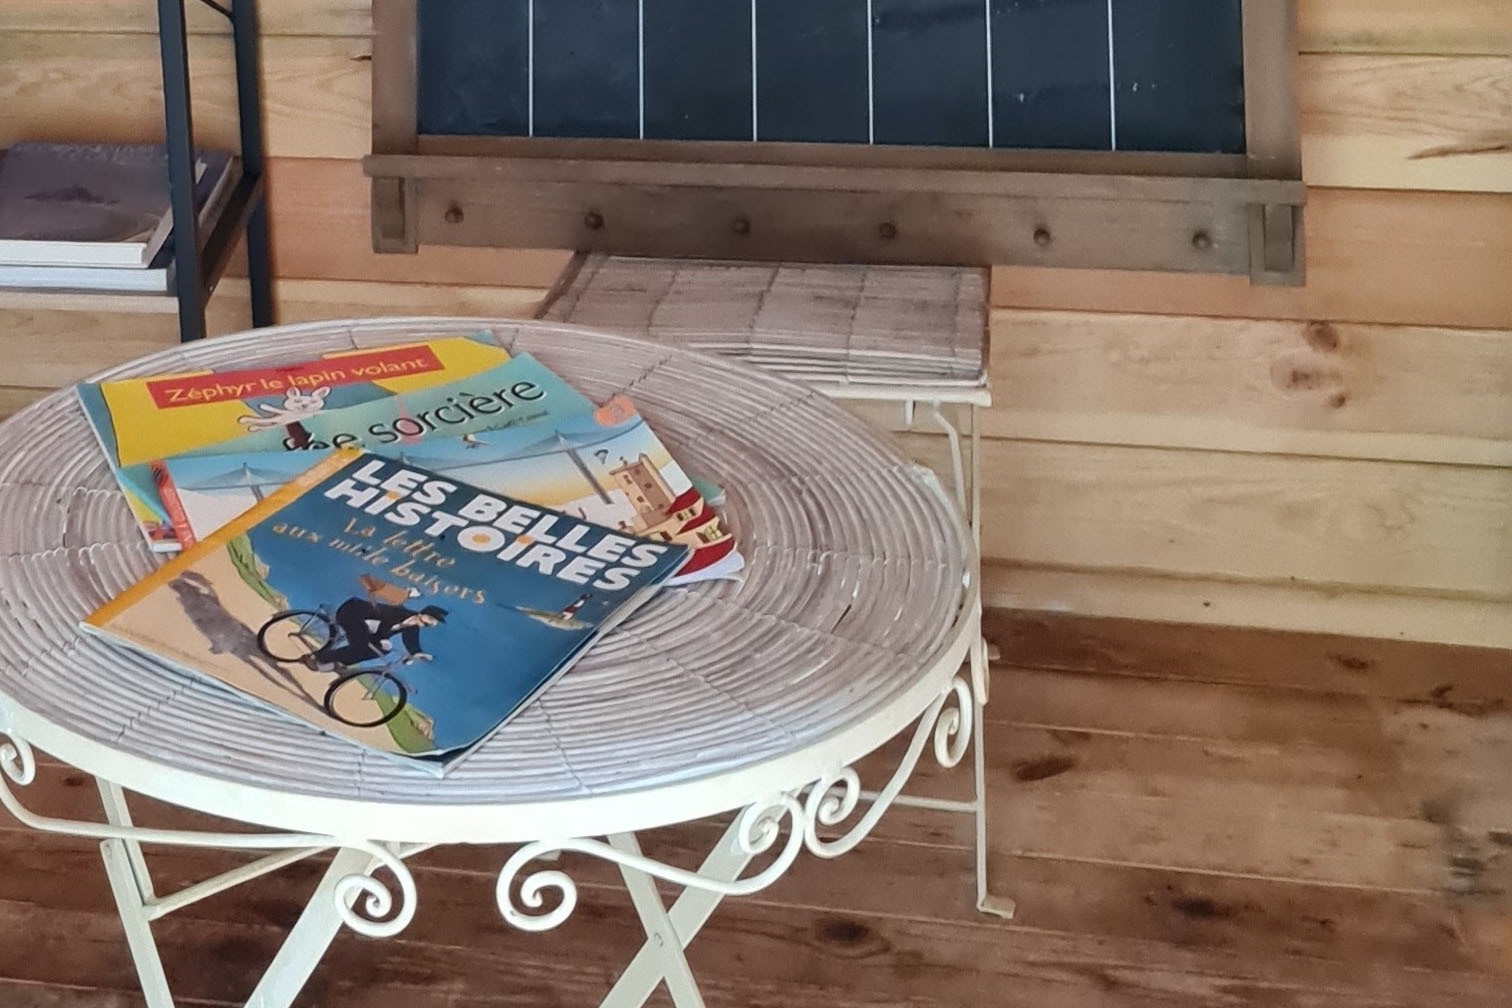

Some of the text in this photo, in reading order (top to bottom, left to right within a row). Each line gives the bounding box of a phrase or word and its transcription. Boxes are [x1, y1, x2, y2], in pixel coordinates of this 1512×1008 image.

[163, 354, 429, 405] Zéphyr le lapin volant
[368, 377, 546, 446] sorcière
[323, 478, 641, 592] HISTOIRES
[343, 516, 456, 570] La lettre
[351, 459, 669, 570] LES BELLES
[271, 521, 487, 605] aux mille baisers
